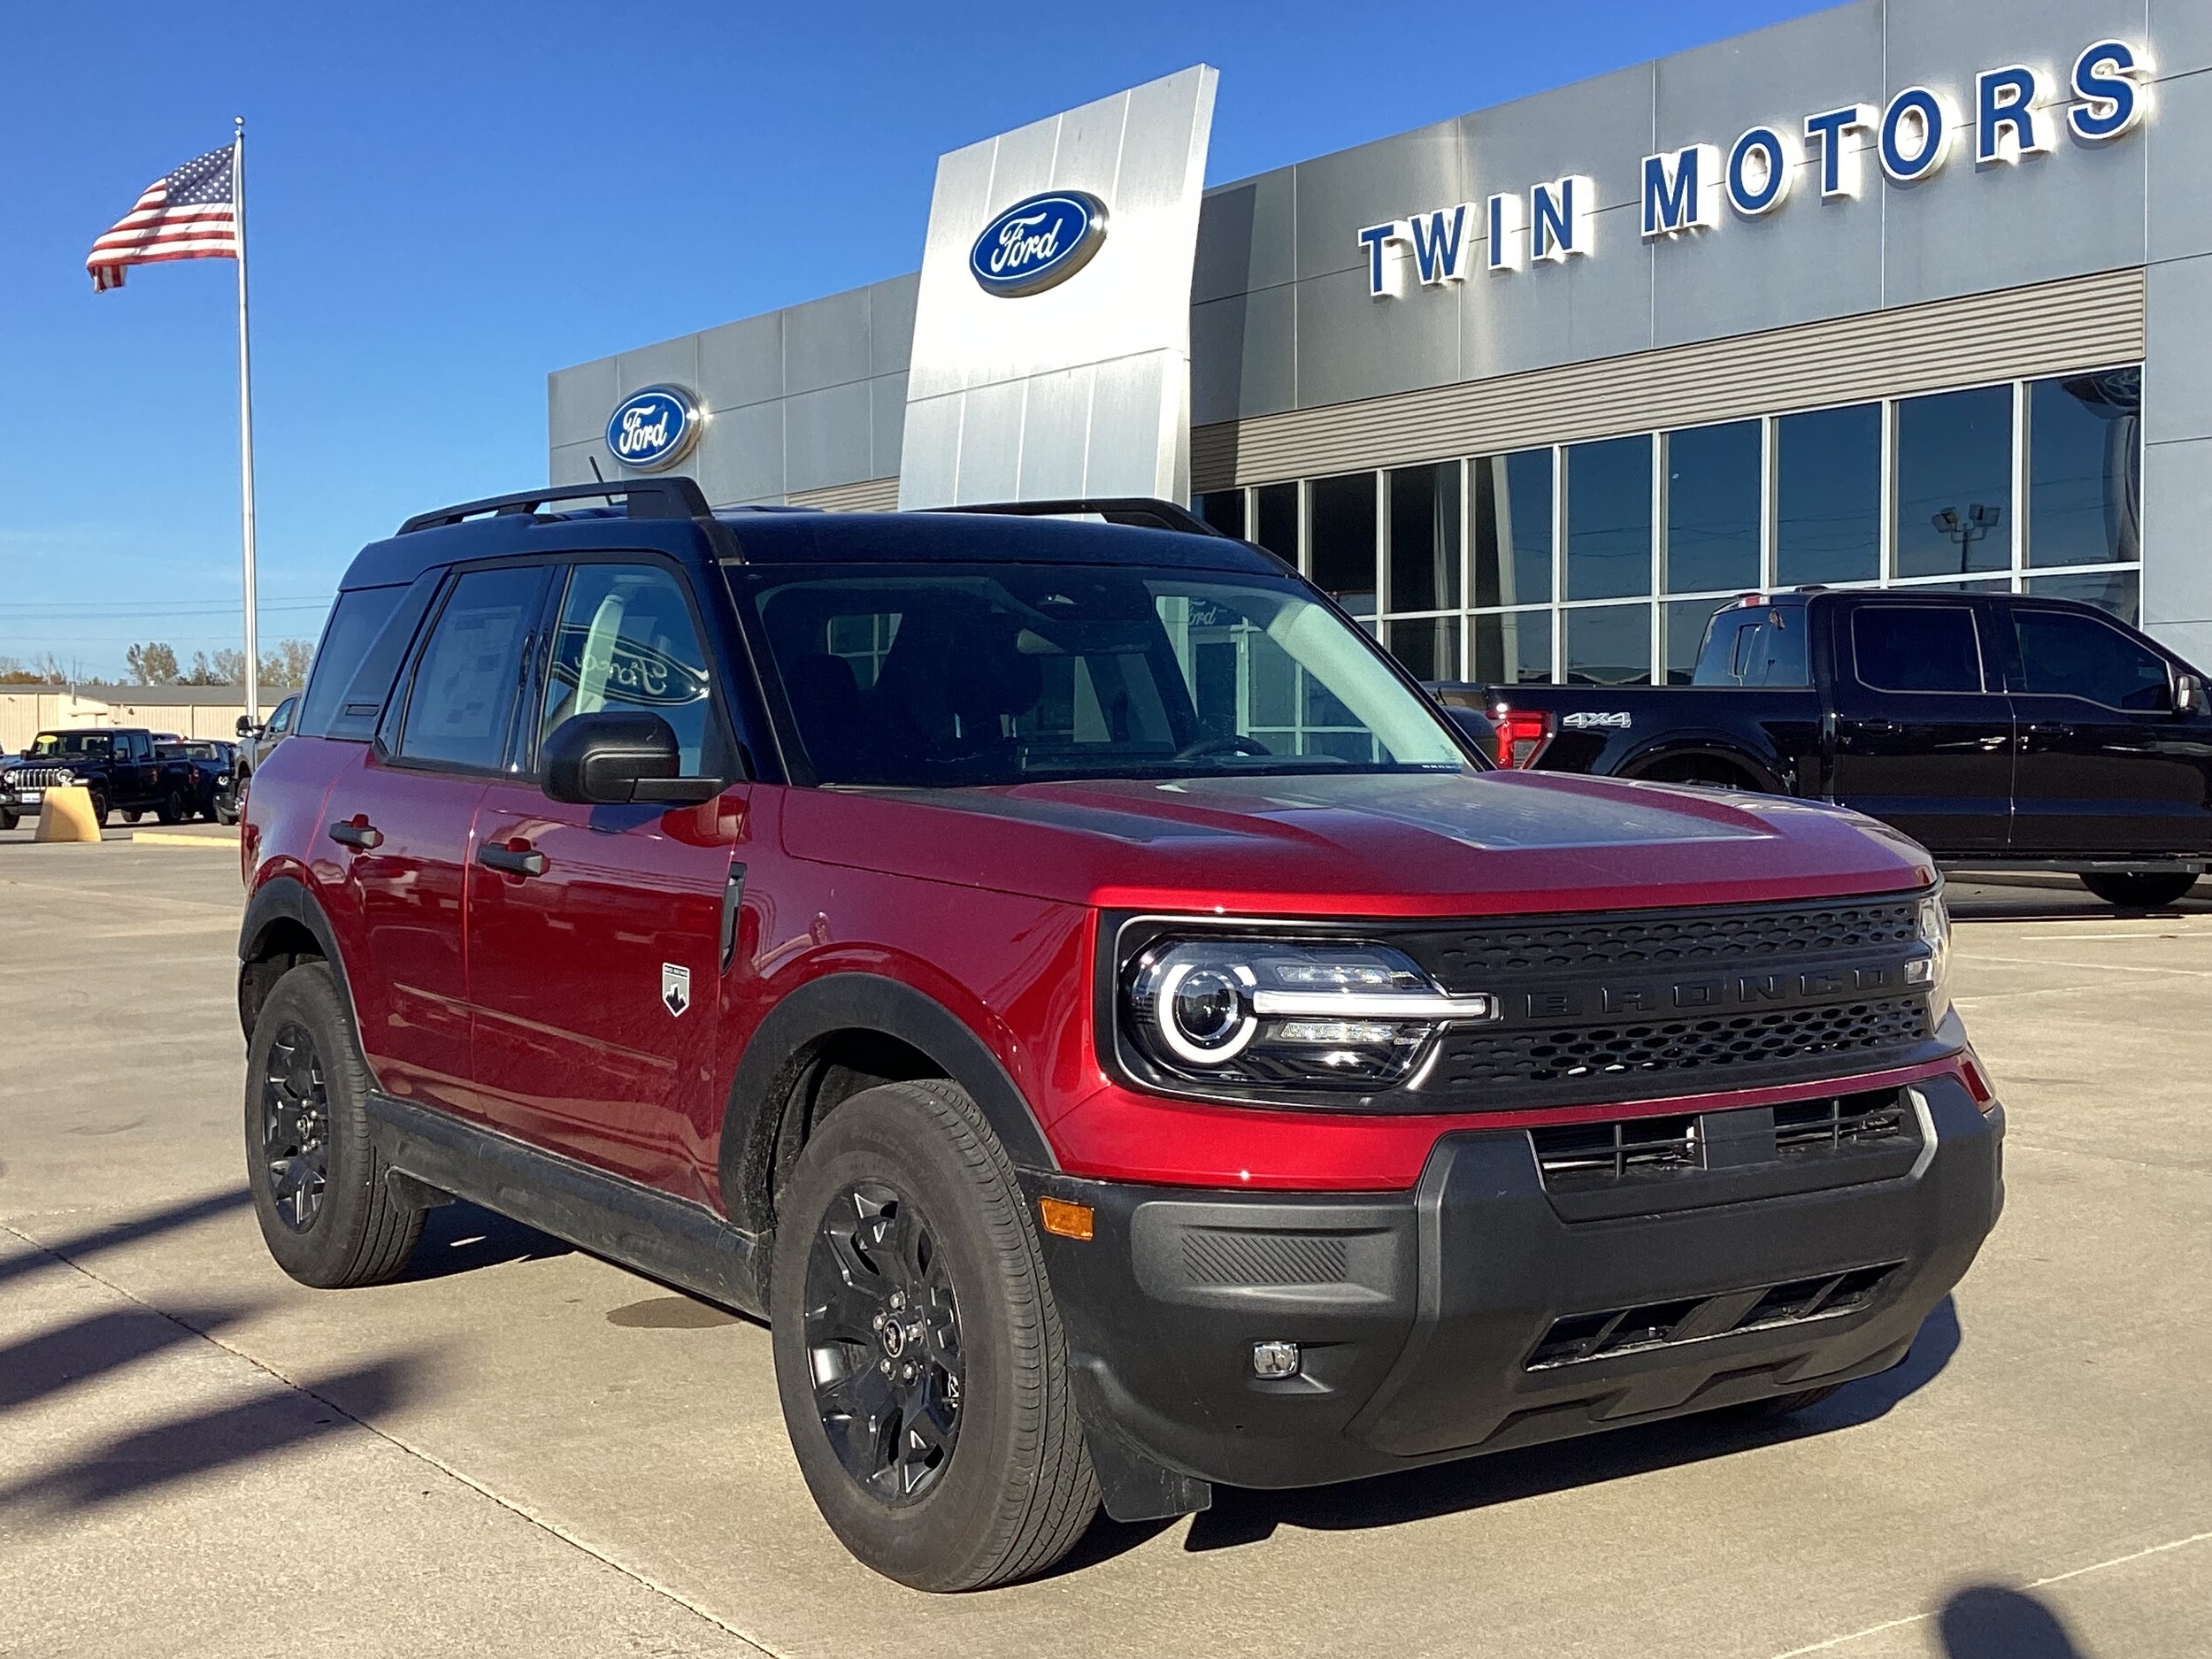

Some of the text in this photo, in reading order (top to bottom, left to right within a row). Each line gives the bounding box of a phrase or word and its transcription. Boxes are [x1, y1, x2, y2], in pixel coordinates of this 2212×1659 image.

[1357, 38, 2147, 296] TWIN MOTORS
[990, 212, 1064, 273] Ford
[619, 404, 669, 455] Ford
[1525, 966, 1895, 1018] BRONCO
